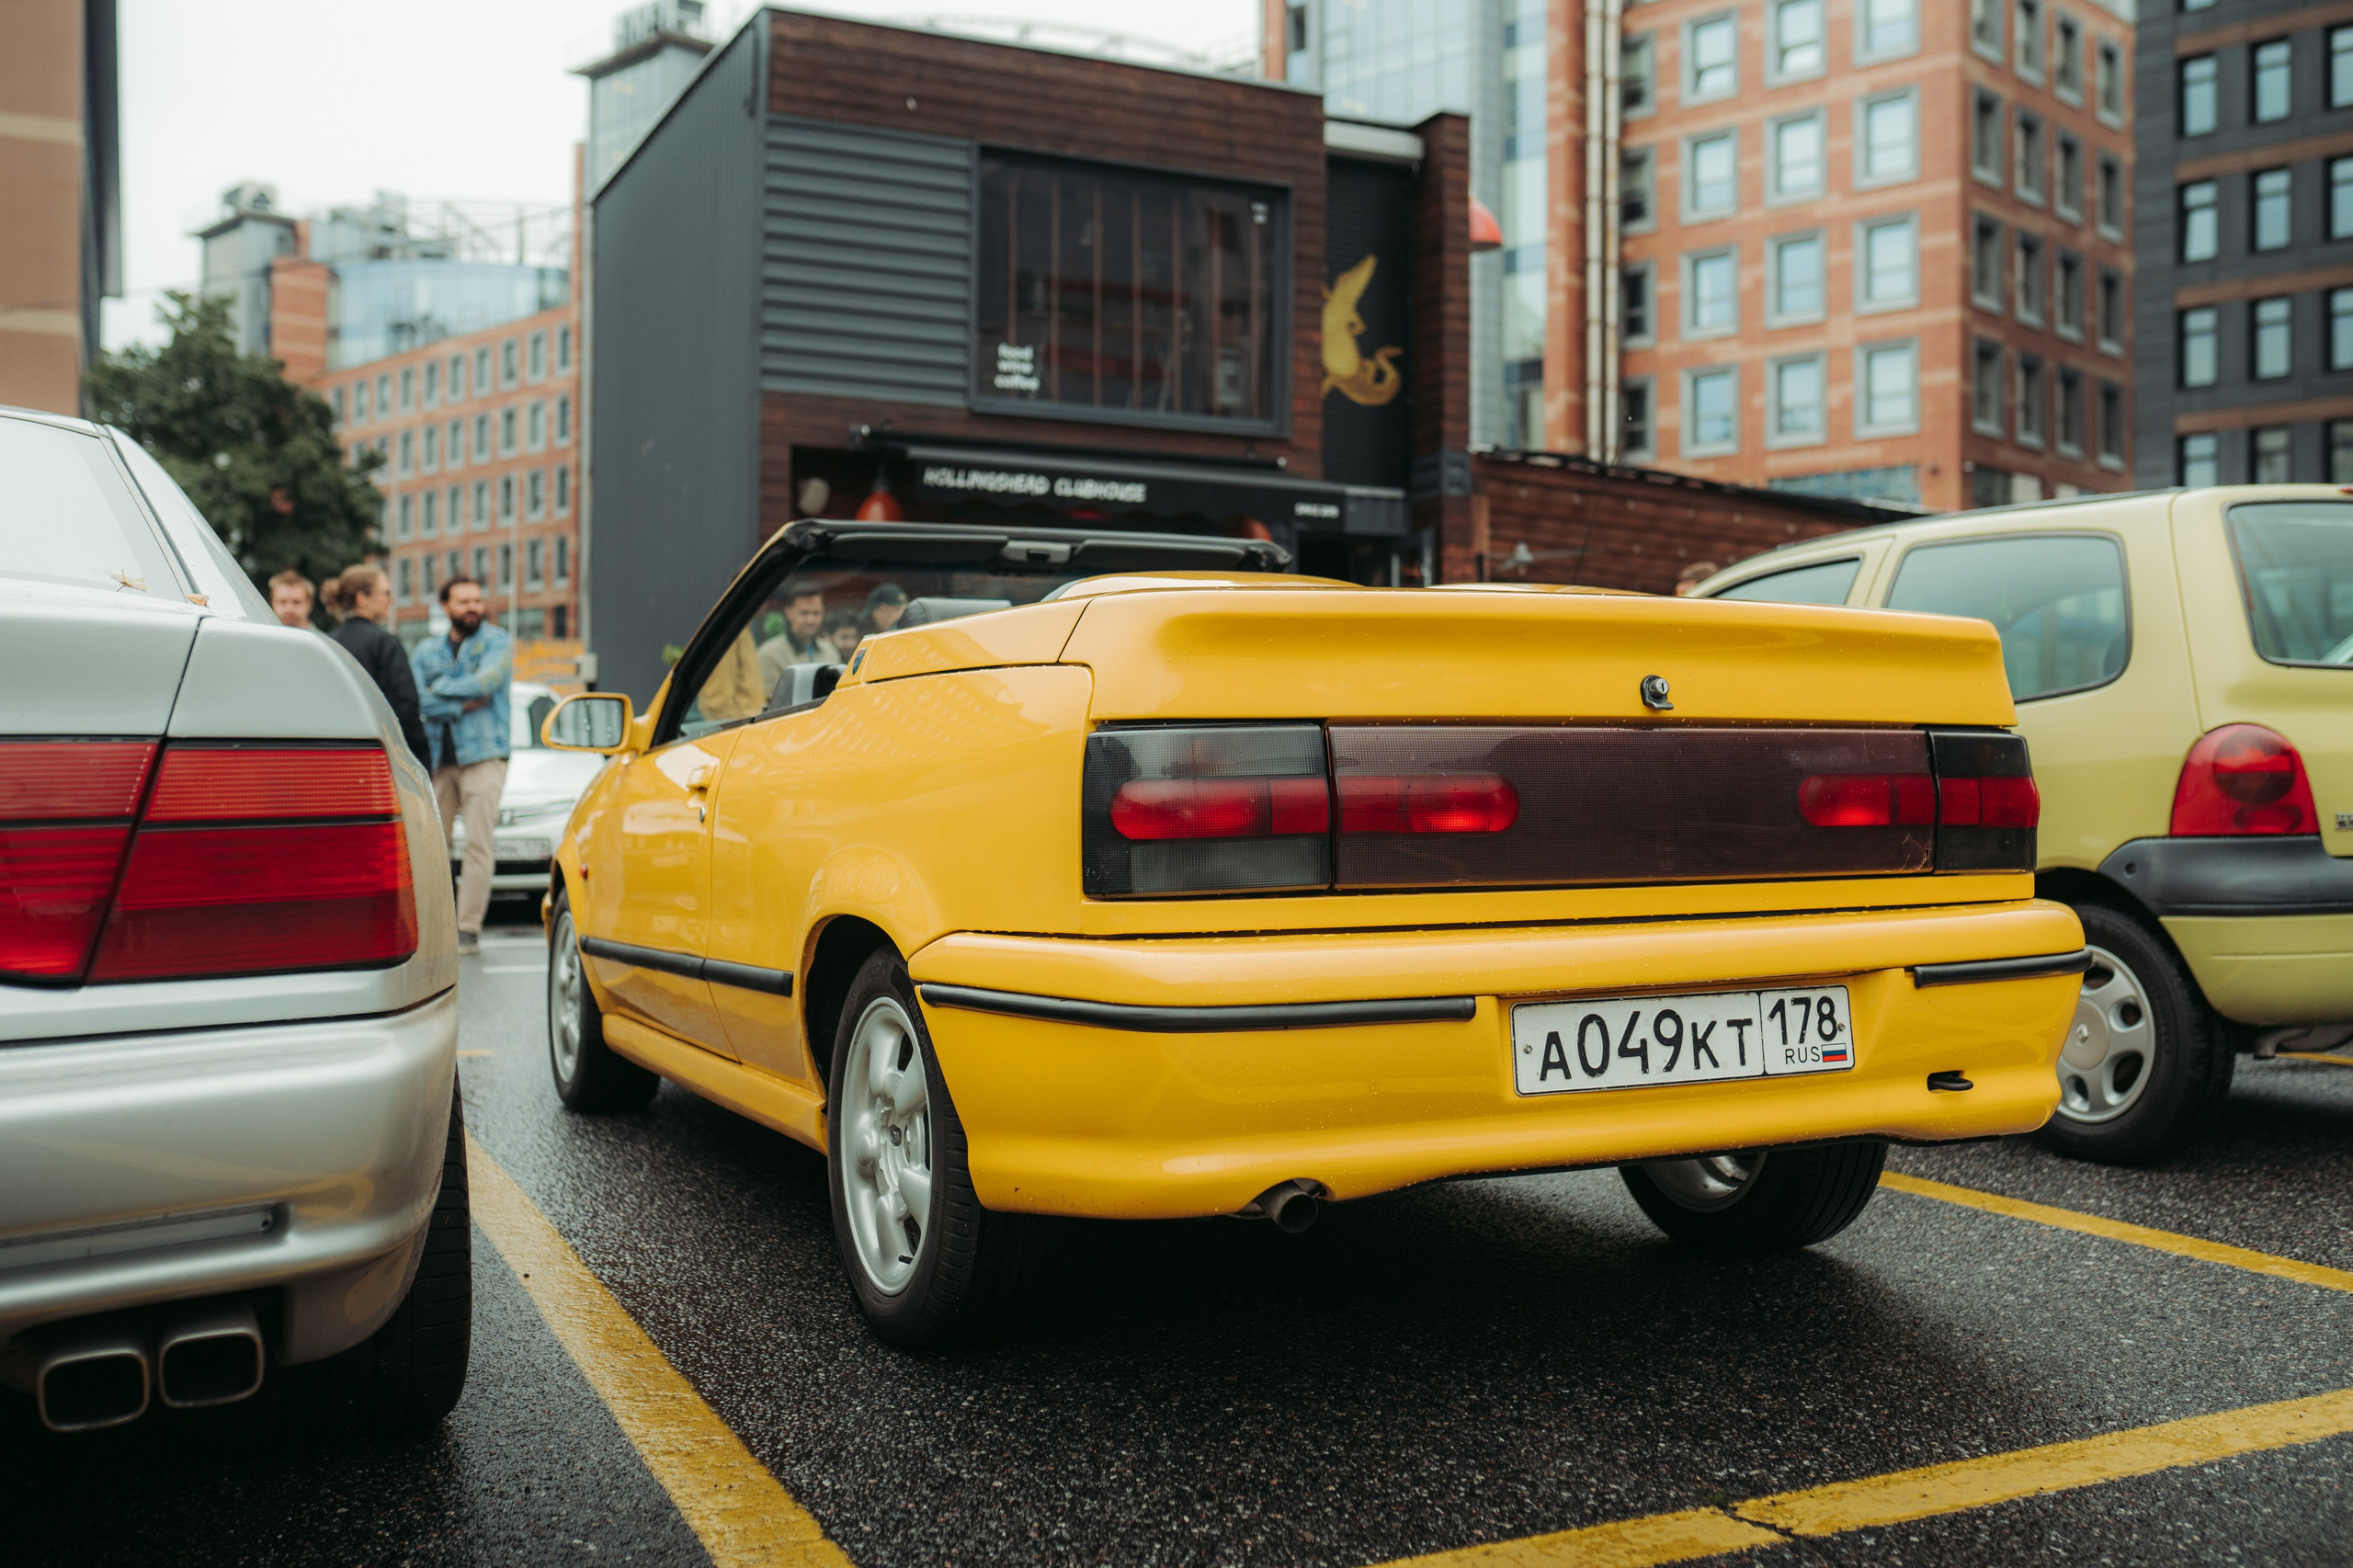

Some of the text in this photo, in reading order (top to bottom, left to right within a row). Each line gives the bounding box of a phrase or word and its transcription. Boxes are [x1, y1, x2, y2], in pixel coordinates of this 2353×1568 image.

[994, 373, 1040, 391] coffee
[923, 466, 1147, 503] HOLLINGSHEAD CLUBHOUSE
[1768, 995, 1837, 1045] 178
[1785, 1046, 1821, 1064] RUS
